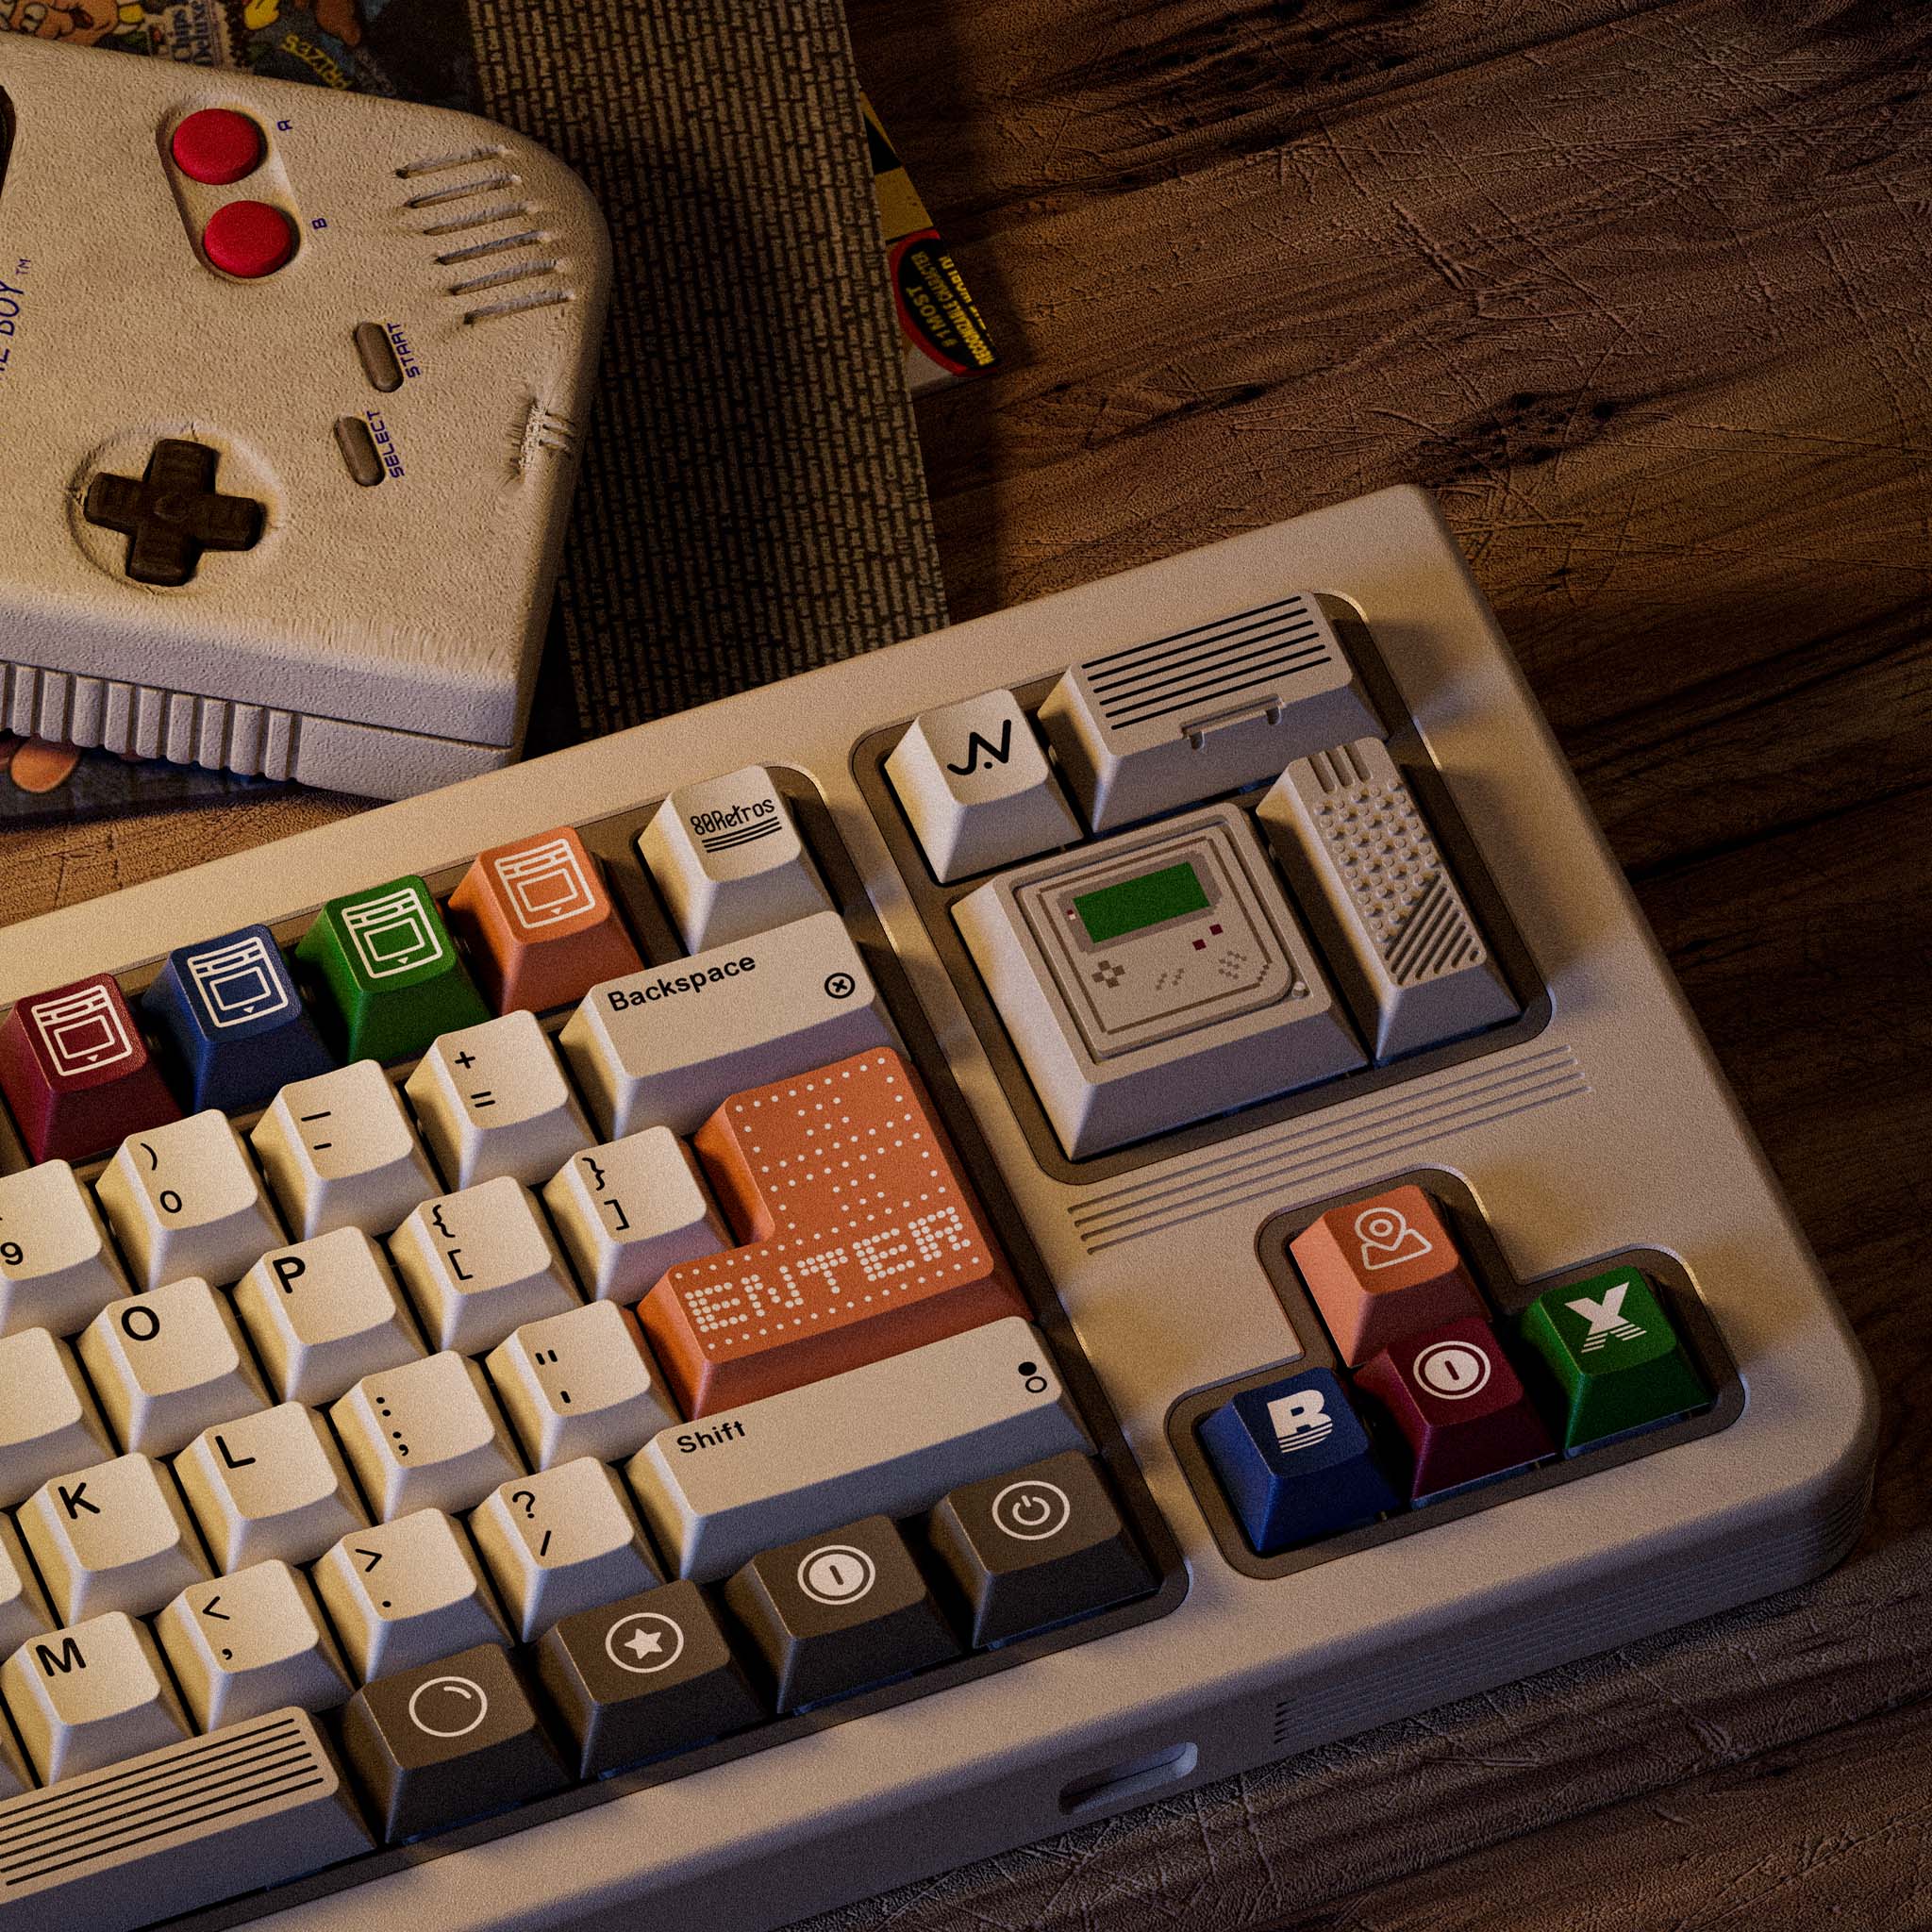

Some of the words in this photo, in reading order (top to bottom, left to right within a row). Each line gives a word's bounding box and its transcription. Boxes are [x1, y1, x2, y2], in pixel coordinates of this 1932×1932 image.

[277, 120, 292, 131] A
[311, 218, 327, 229] B
[910, 250, 954, 302] CHARACTER
[906, 286, 947, 331] MOST
[387, 323, 421, 378] START
[941, 300, 995, 367] RECOGNIZABLE
[367, 410, 405, 478] SELECT
[608, 957, 756, 1011] Backspace
[1, 1241, 24, 1265] 9
[685, 1206, 971, 1333] ENTER
[273, 1257, 306, 1293] P
[122, 1306, 159, 1341] O
[1564, 1281, 1646, 1354] X
[677, 1420, 746, 1454] Shift
[1267, 1389, 1333, 1454] B
[216, 1436, 256, 1468] L
[58, 1482, 100, 1519] K
[512, 1491, 536, 1519] ?
[36, 1638, 87, 1676] M
